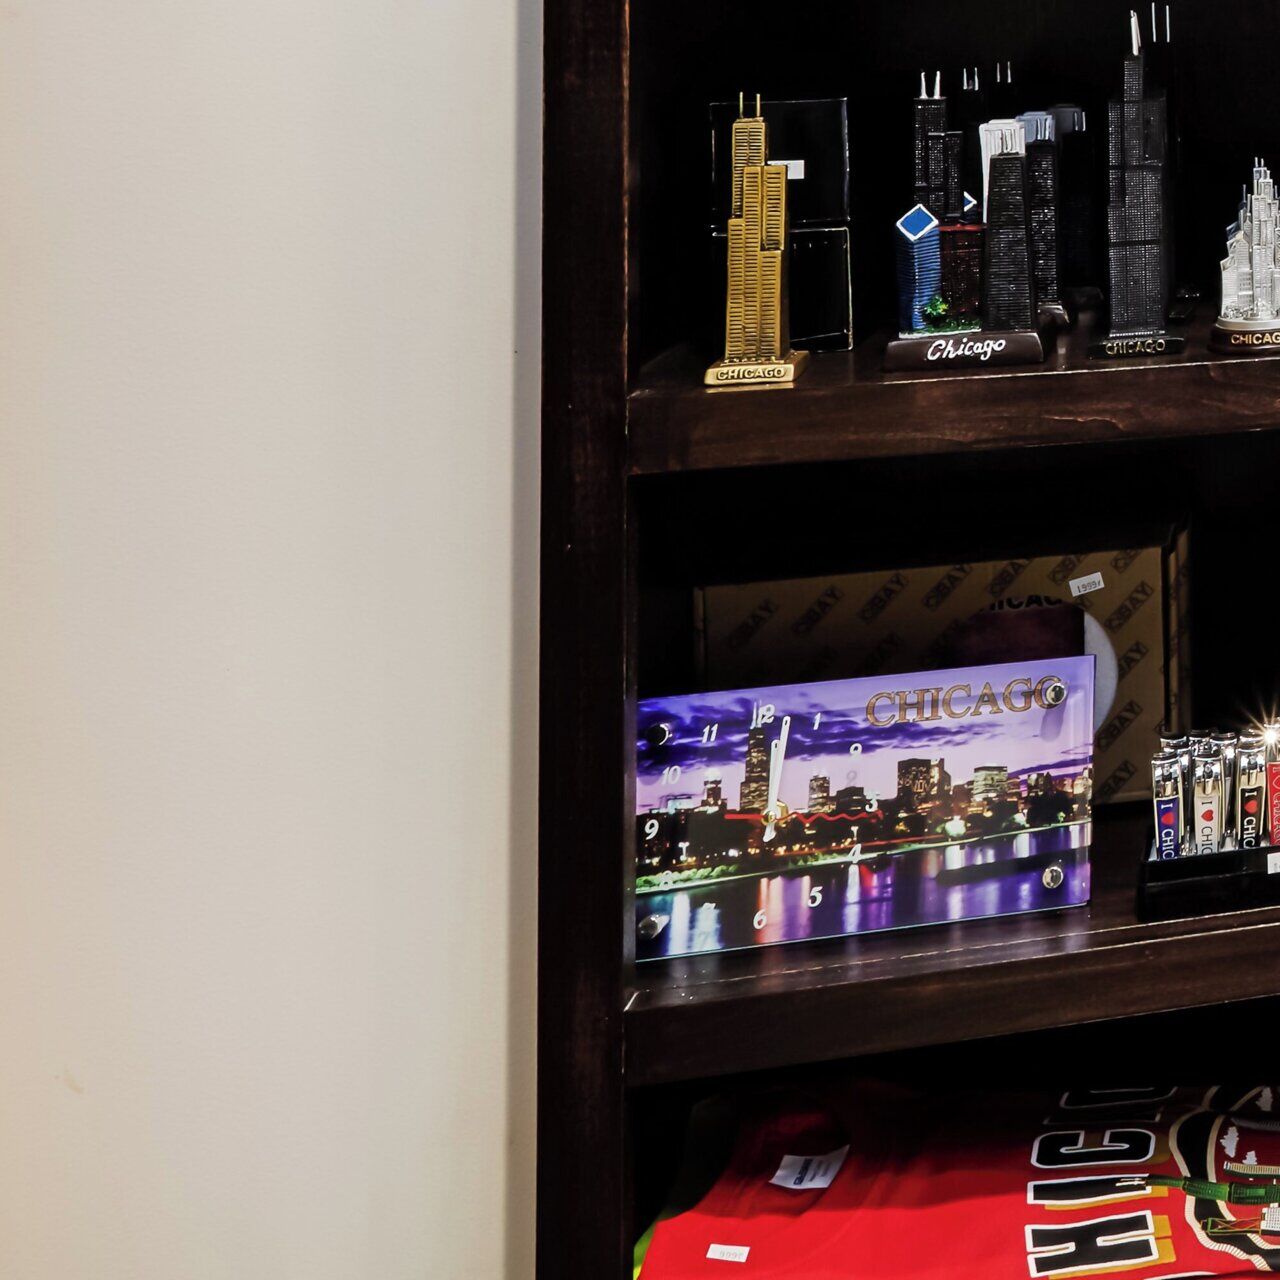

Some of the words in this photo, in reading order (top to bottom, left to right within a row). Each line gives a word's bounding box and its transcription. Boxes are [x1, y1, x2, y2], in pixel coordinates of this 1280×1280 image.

[926, 337, 1006, 362] Chicago
[865, 675, 1065, 728] CHICAGO
[644, 820, 659, 840] 9
[807, 886, 823, 907] 5
[753, 910, 767, 929] 6
